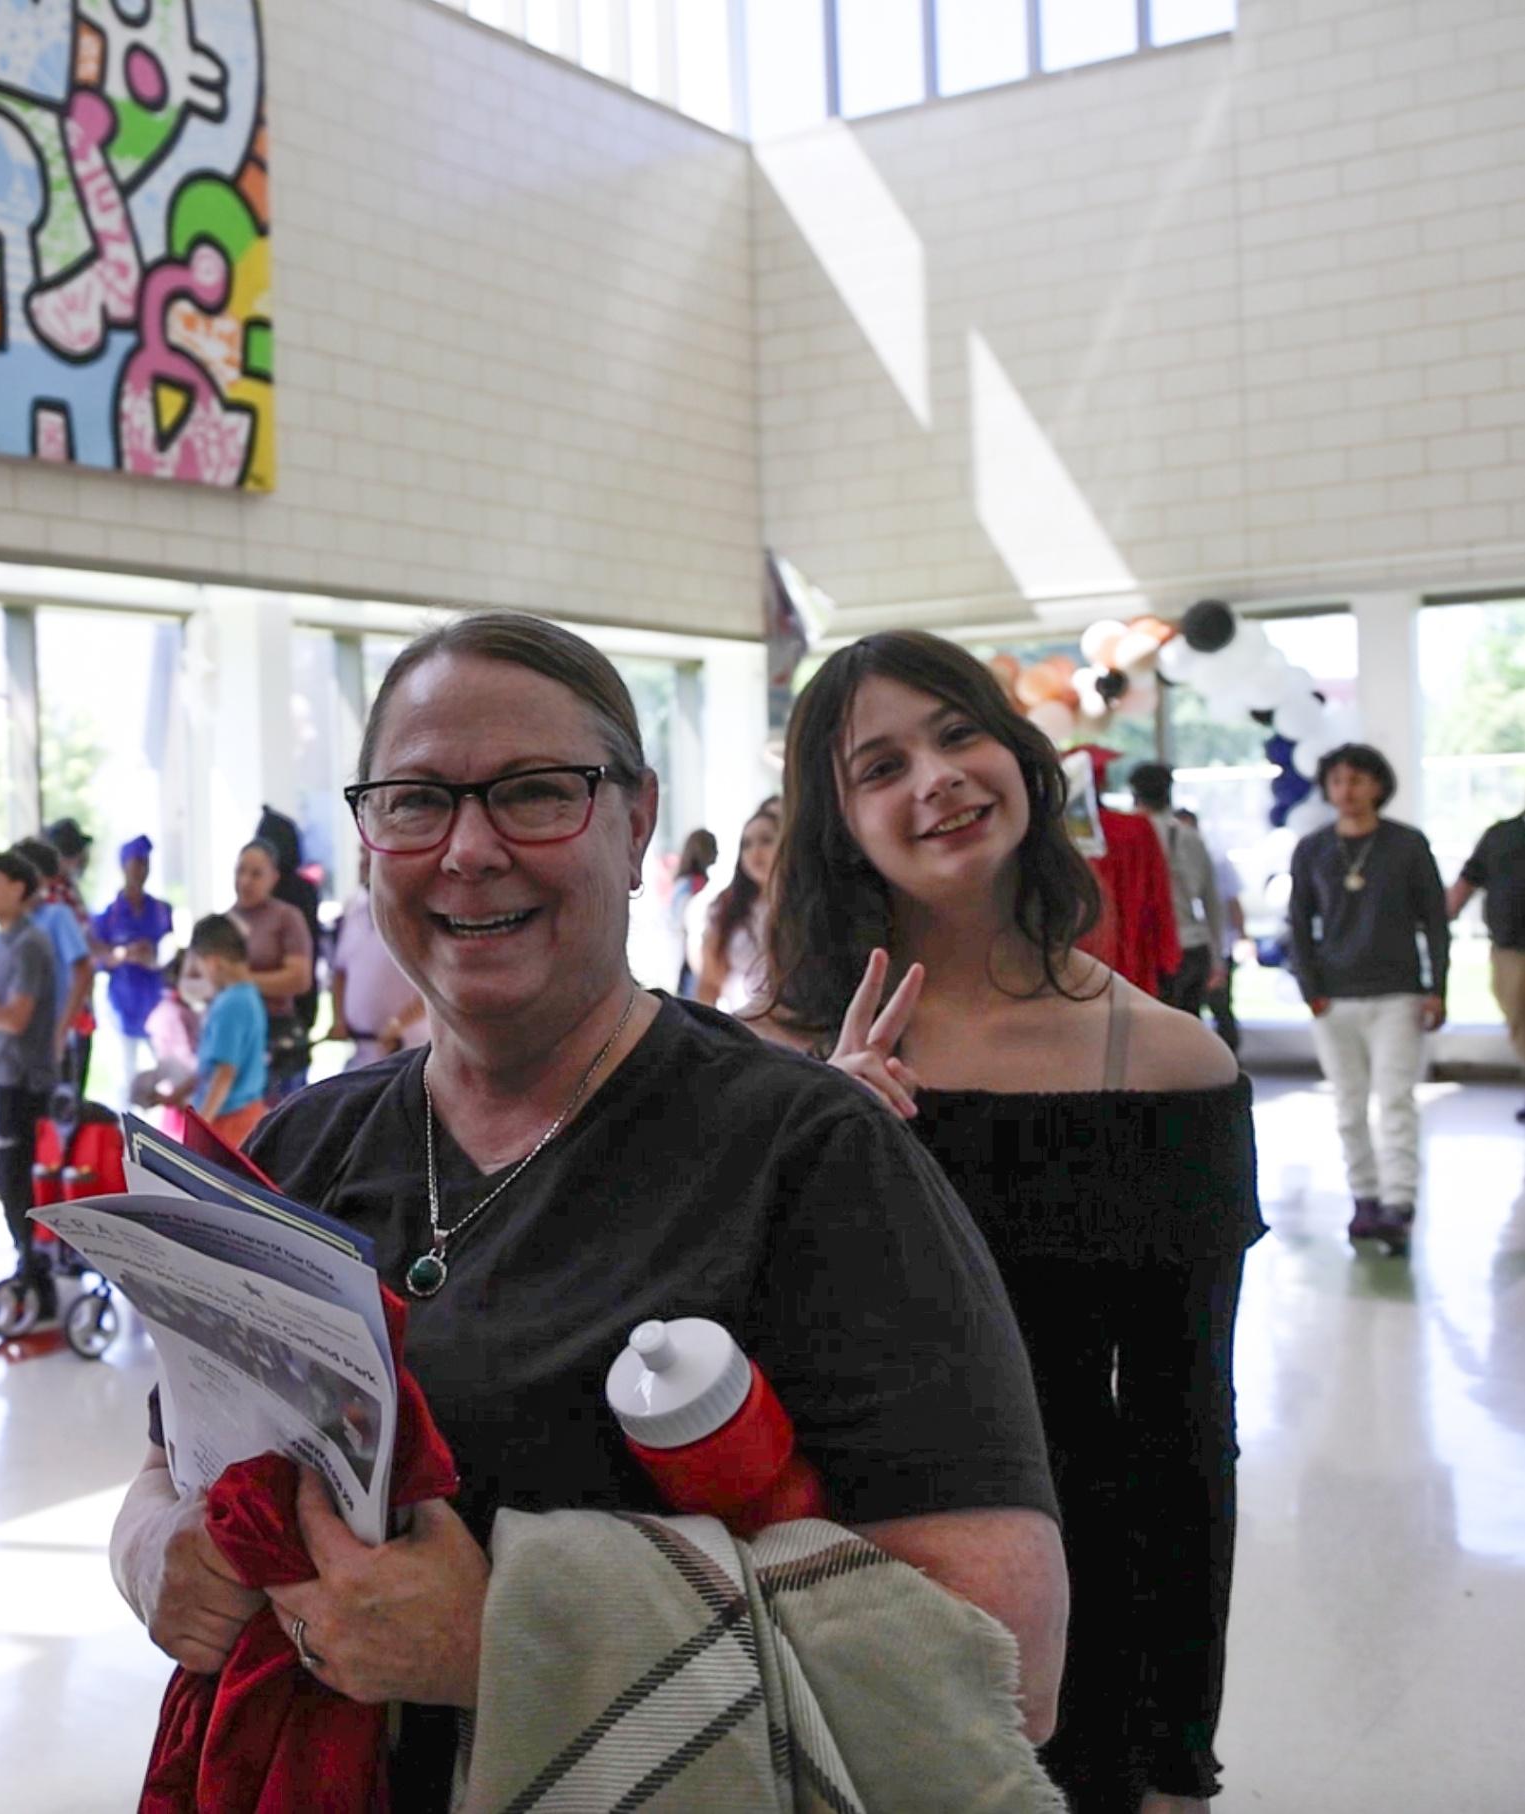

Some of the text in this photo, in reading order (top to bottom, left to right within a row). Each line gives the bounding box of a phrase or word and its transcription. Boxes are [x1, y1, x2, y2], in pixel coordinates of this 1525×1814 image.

[230, 1229, 270, 1249] Program
[282, 1325, 341, 1363] Garfield
[342, 1357, 379, 1387] Park
